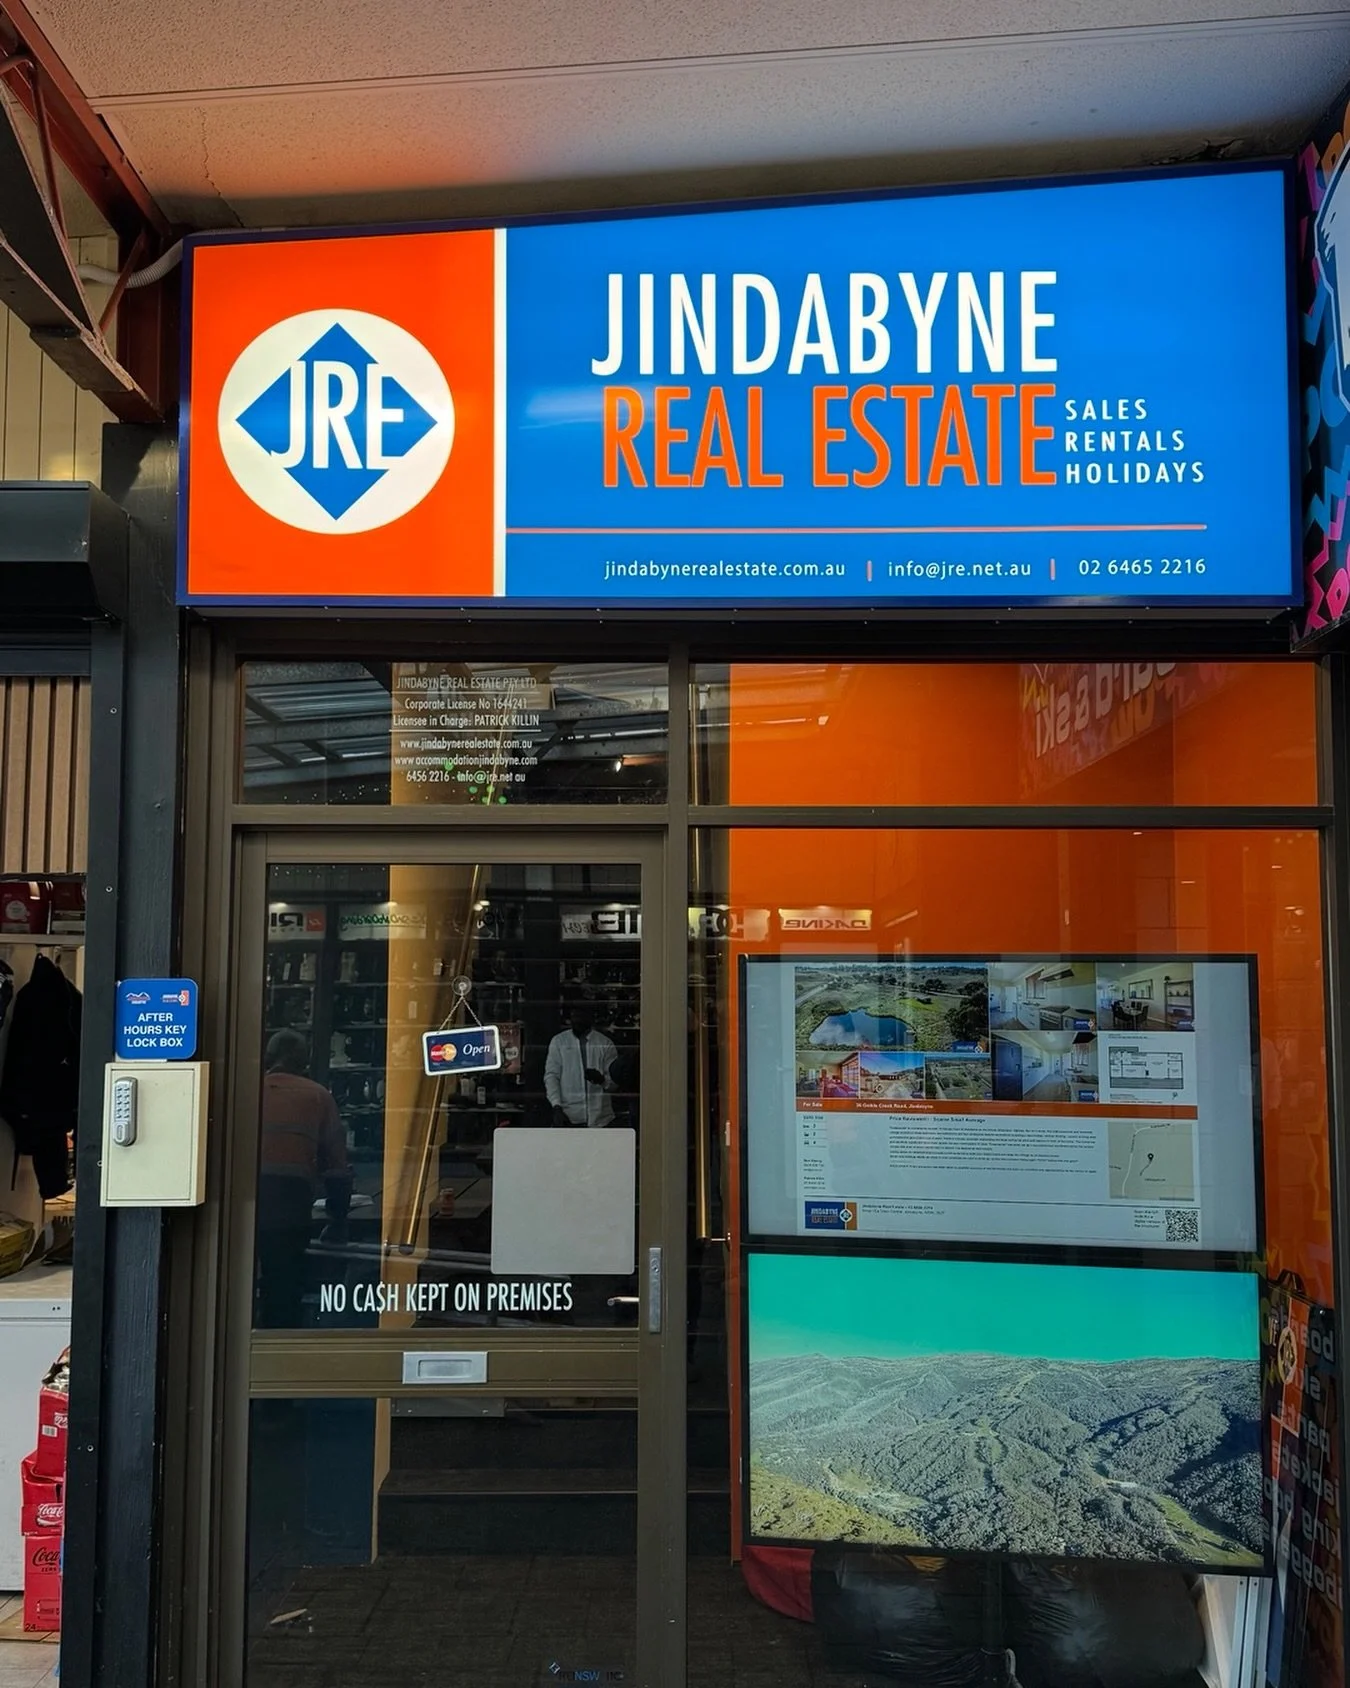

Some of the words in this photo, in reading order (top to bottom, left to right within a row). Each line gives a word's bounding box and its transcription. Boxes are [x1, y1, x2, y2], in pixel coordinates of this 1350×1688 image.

[591, 271, 1058, 376] JINDABYNE
[271, 360, 405, 470] JRE
[1065, 398, 1147, 421] SALES
[602, 386, 784, 488] REAL
[812, 383, 1057, 488] ESTATE
[1065, 430, 1185, 452] RENTALS
[1066, 461, 1204, 484] HOLIDAYS
[604, 560, 845, 580] jindabynerealestate.com.au
[888, 560, 1031, 580] info@jre.net.au
[1079, 559, 1100, 575] 02
[1107, 559, 1153, 575] 6465
[1161, 558, 1206, 574] 2216
[396, 676, 445, 690] JINDABYNE
[447, 676, 468, 689] REAL
[471, 676, 500, 689] ESTATE
[404, 698, 445, 711] Corporate
[447, 698, 477, 710] License
[478, 698, 491, 710] No
[393, 714, 428, 727] Licensee
[429, 714, 438, 727] in
[439, 714, 472, 728] Charge:
[474, 714, 509, 727] PATRICK
[511, 714, 540, 727] KILLIN
[400, 736, 533, 752] www.jindabynerealestate.com.au
[406, 770, 428, 783] 6456
[429, 770, 450, 783] 2216
[138, 1012, 173, 1022] AFTER
[124, 1025, 162, 1035] HOURS
[165, 1024, 187, 1034] KEY
[127, 1037, 157, 1047] LOCK
[160, 1037, 183, 1047] BOX
[462, 1043, 491, 1057] Open
[320, 1283, 346, 1312] NO
[406, 1283, 449, 1312] KEPT
[454, 1282, 480, 1312] ON
[487, 1282, 573, 1311] PREMISES
